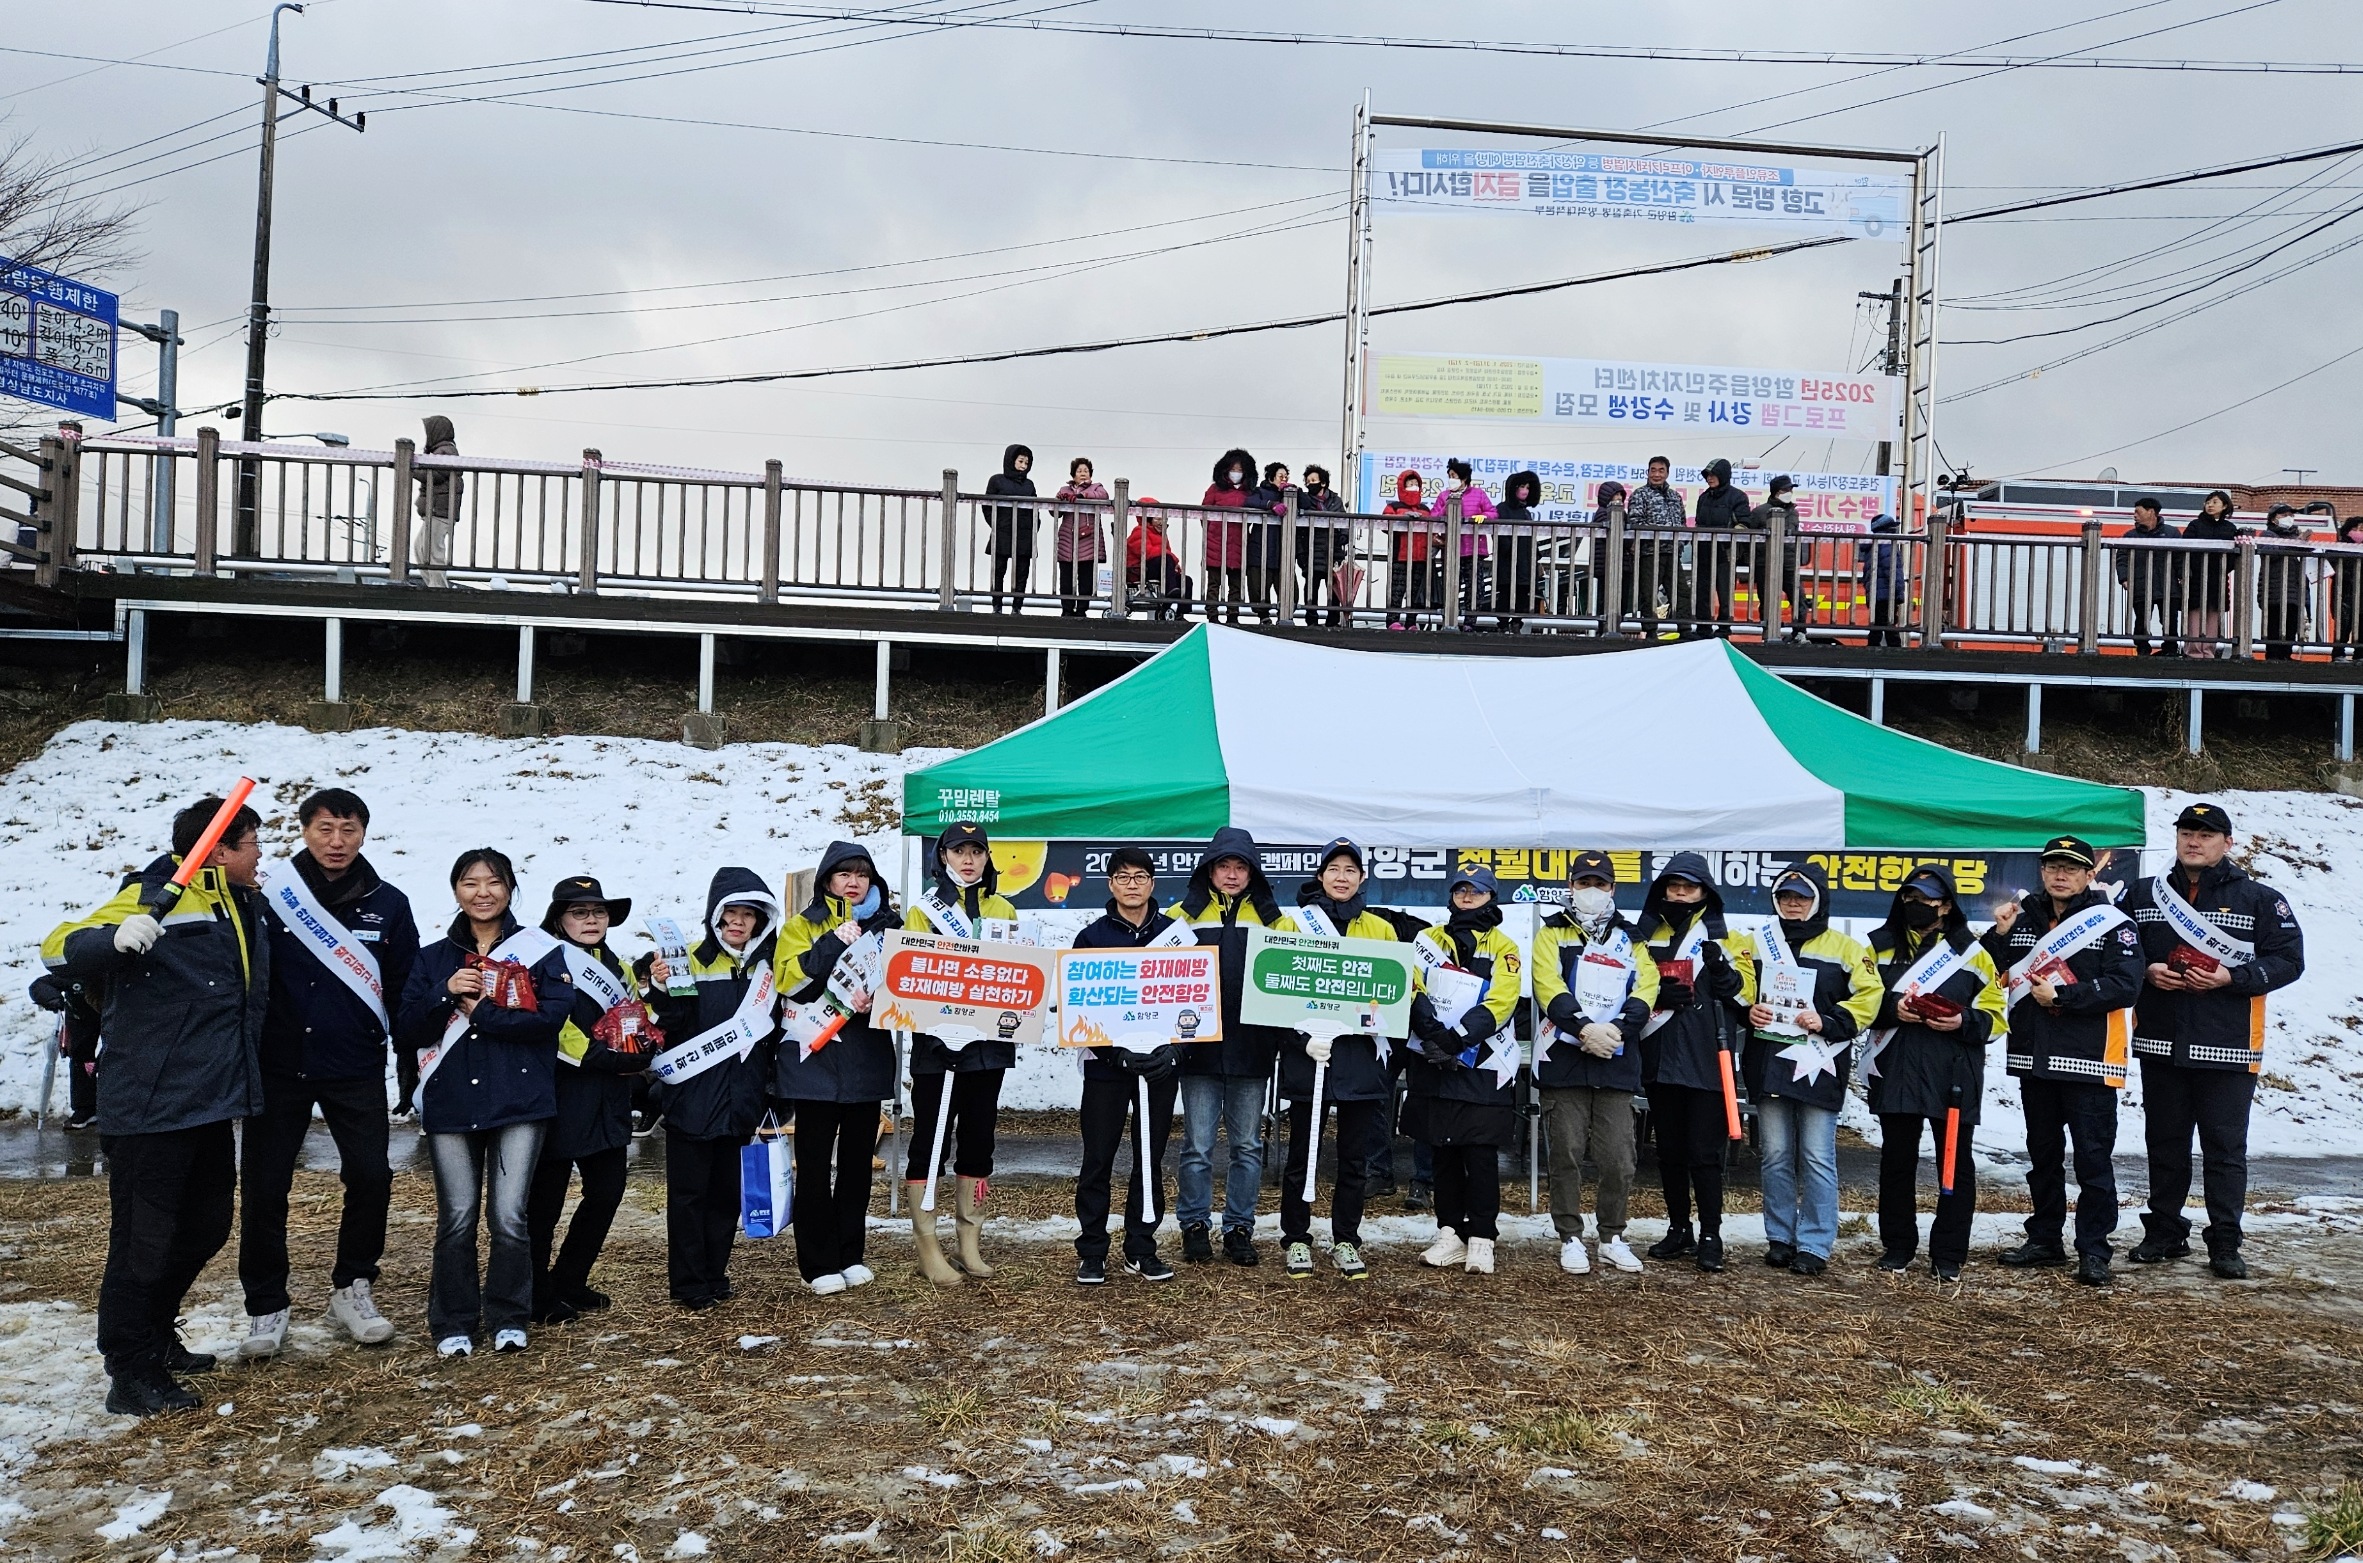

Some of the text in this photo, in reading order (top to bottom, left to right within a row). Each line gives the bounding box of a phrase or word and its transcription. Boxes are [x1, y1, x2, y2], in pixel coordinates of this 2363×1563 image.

[73, 354, 108, 379] 2.5m
[937, 788, 1001, 808] 꾸밈렌탈
[938, 810, 1000, 823] 010.3553.8454
[2168, 903, 2207, 940] 안전문화
[2206, 936, 2233, 955] 확산
[900, 936, 936, 949] 대한민국
[937, 940, 980, 954] 안전한바퀴
[1264, 935, 1340, 950] 대한민국 안전한바퀴
[910, 956, 1029, 985] 불나면 소용없다
[1067, 958, 1209, 981] 참여하는 화재예방
[1291, 955, 1373, 978] 첫째도 안전
[898, 976, 1033, 1006] 화재예방 실천하기
[1067, 983, 1210, 1006] 확산되는 안전함양
[1265, 972, 1396, 1000] 둘째도 안전입니다!
[954, 1007, 976, 1017] 함양군
[1137, 1011, 1159, 1020] 함양군
[675, 1050, 700, 1070] 확산
[700, 1029, 738, 1056] 캠페인
